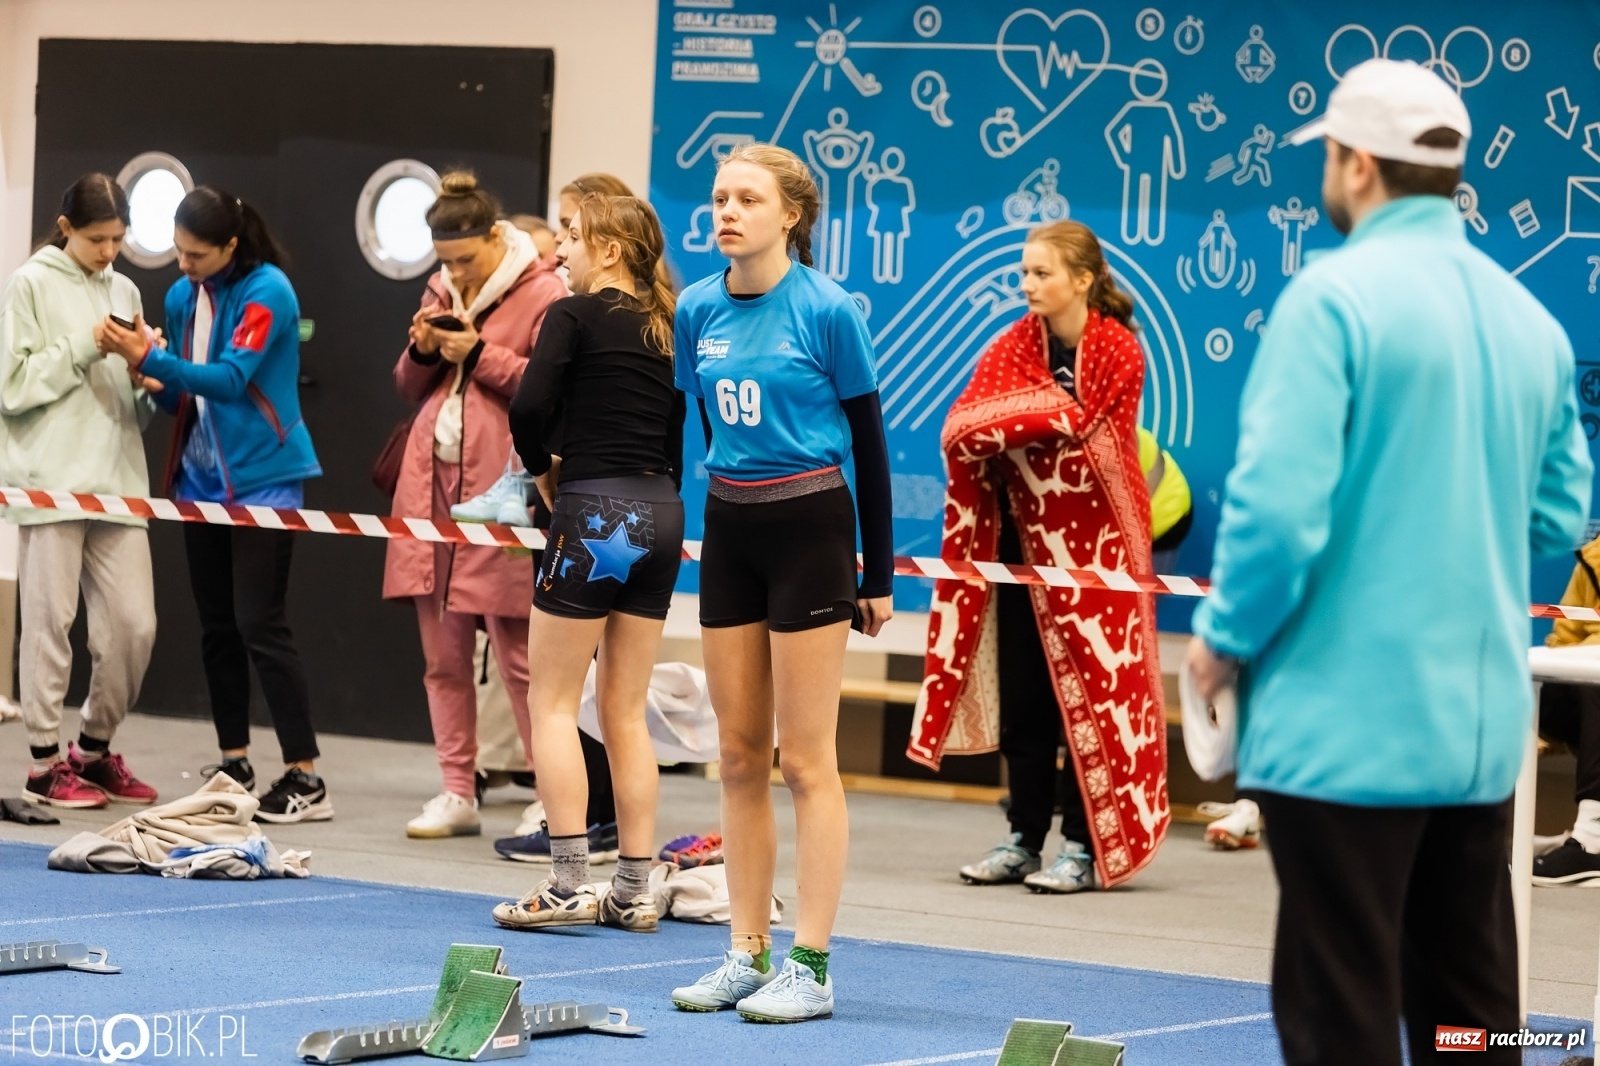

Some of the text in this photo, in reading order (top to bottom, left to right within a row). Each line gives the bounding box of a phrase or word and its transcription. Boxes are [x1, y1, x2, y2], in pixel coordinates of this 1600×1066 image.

[697, 338, 715, 349] JUST
[705, 345, 729, 355] TEAM
[716, 378, 761, 427] 69
[548, 549, 561, 579] Fundacja
